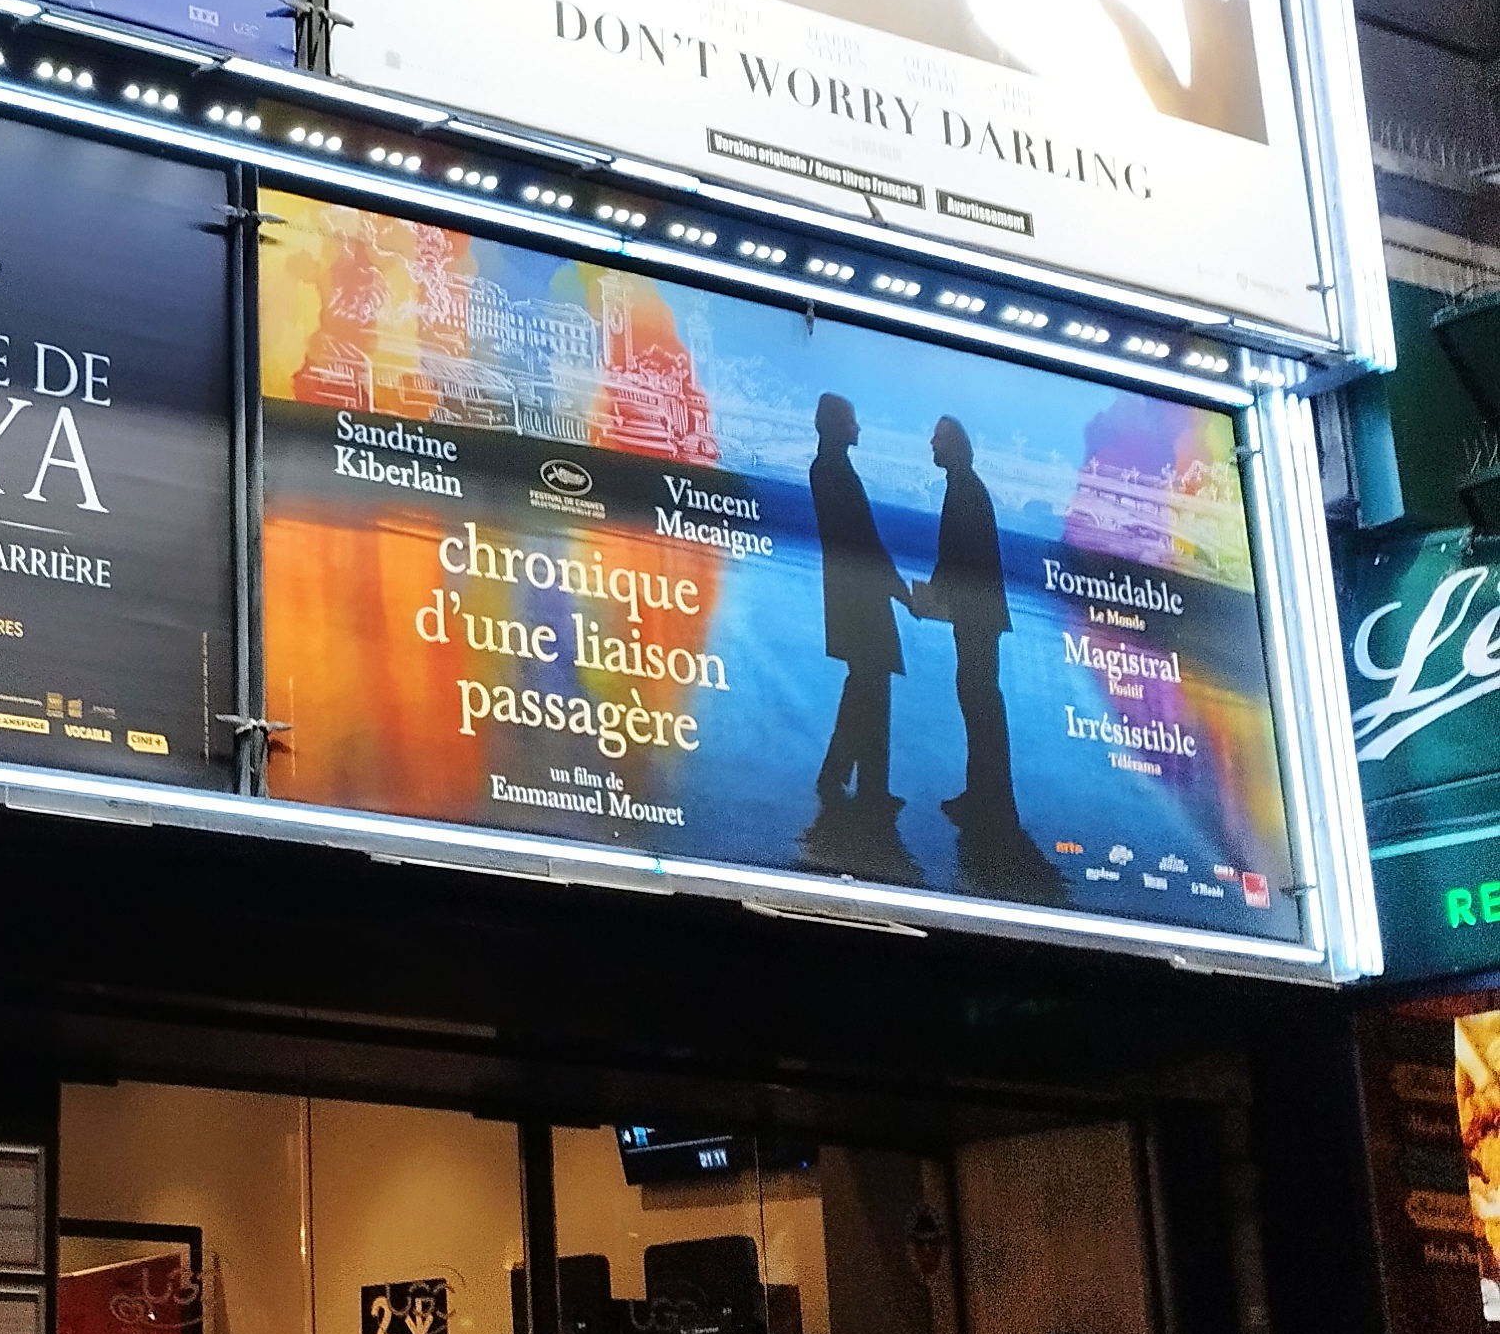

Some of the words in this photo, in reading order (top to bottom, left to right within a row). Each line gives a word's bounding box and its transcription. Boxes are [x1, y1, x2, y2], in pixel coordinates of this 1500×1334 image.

[738, 50, 921, 138] WORRY
[941, 108, 1156, 203] DARLING
[714, 133, 758, 160] Version
[758, 145, 807, 175] originale
[815, 161, 842, 183] Sous
[947, 196, 1026, 232] Avertissement
[33, 341, 112, 407] DE
[336, 411, 458, 463] Sandrine
[333, 445, 464, 499] Kiberlain
[663, 473, 762, 522] Vincent
[655, 506, 775, 560] Macaigne
[438, 521, 701, 625] chronique
[1041, 557, 1185, 616] Formidable
[1088, 604, 1105, 623] Le
[1105, 607, 1147, 632] Monde
[573, 612, 731, 692] liaison
[1061, 631, 1183, 685] Magistral
[1108, 679, 1145, 701] Positif
[457, 678, 701, 759] passagère
[1064, 704, 1198, 758] Irrésistible
[490, 773, 604, 816] Emmanuel
[607, 793, 687, 829] Mouret
[549, 766, 571, 785] un
[573, 767, 603, 789] film
[605, 770, 625, 791] de
